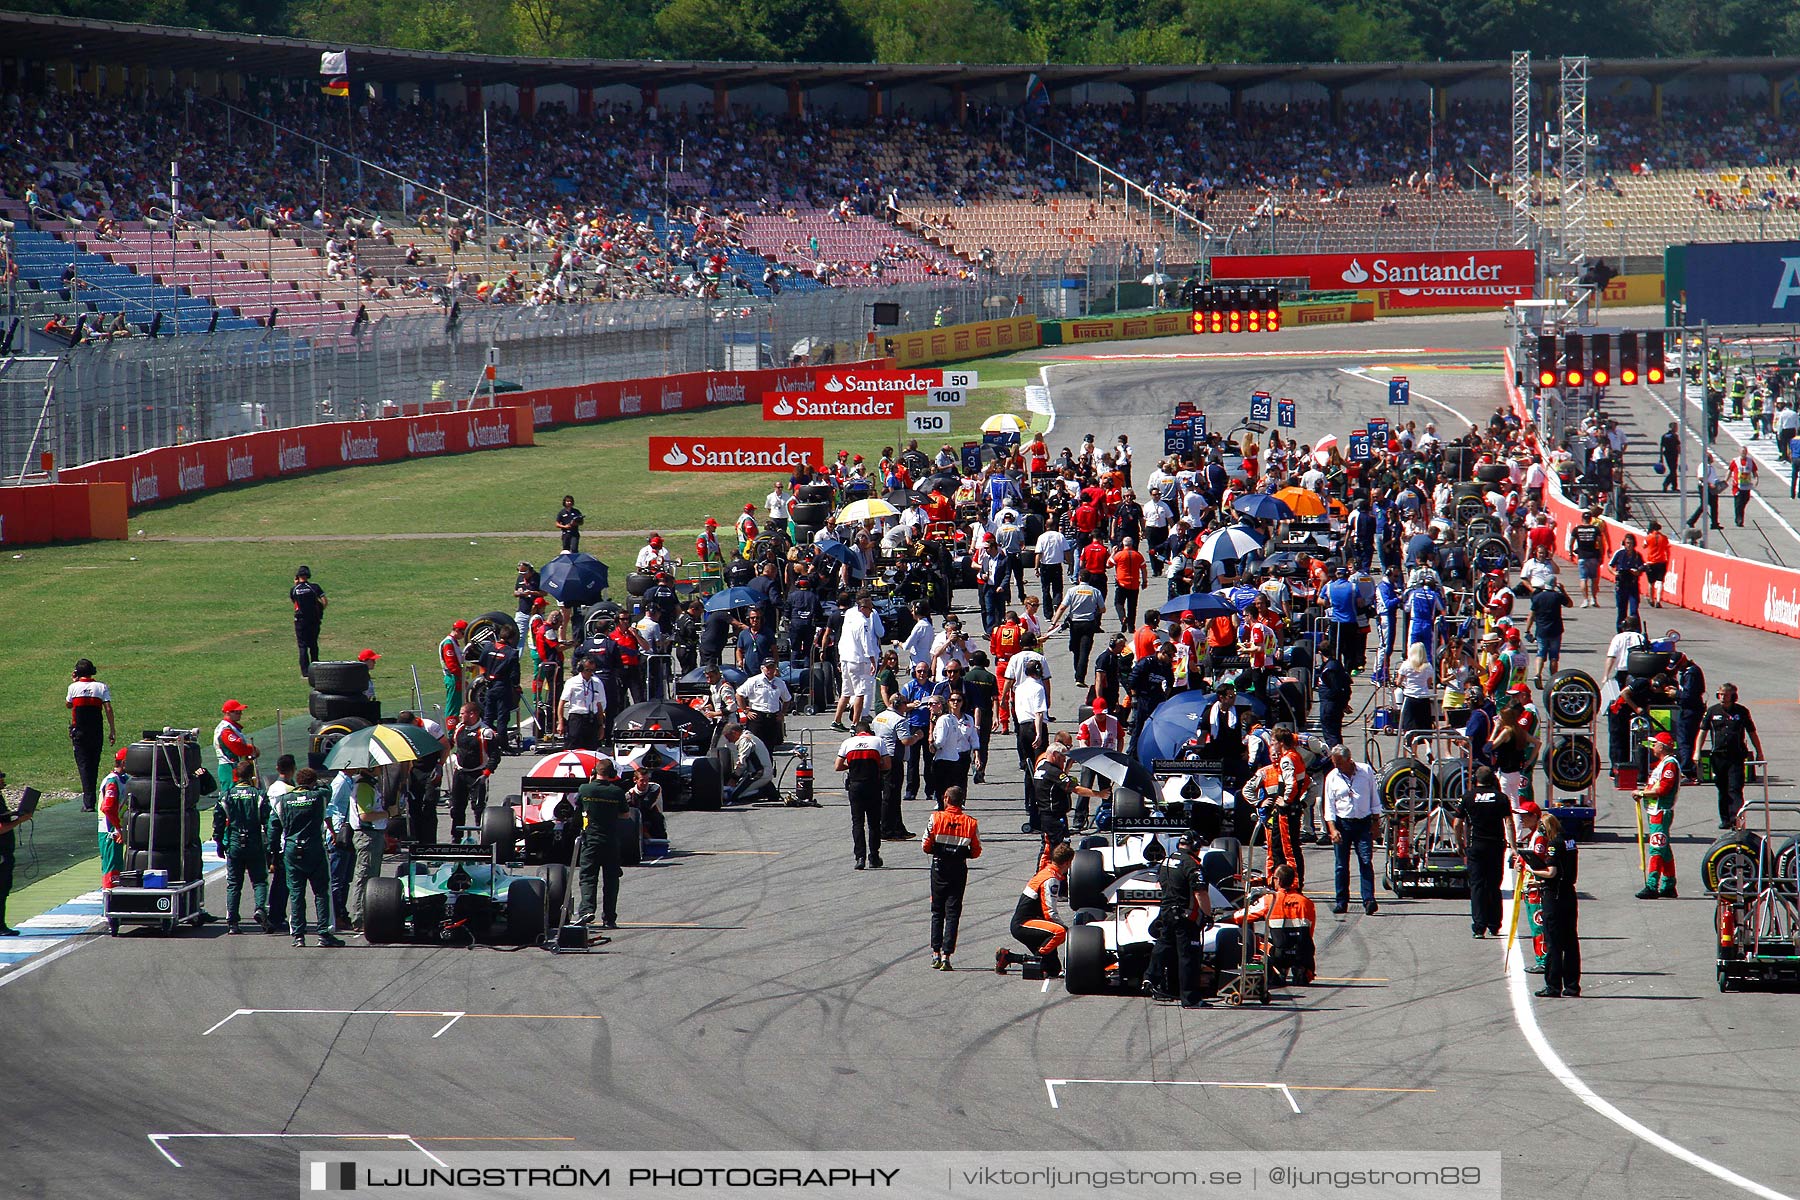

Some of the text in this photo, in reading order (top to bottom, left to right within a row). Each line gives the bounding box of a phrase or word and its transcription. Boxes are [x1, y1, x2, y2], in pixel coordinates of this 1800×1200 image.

[1373, 256, 1502, 283] Santander
[1298, 307, 1345, 323] PIRELLI
[1073, 322, 1114, 338] PIRELLI
[845, 373, 933, 392] Santander
[951, 375, 968, 386] 50
[933, 390, 961, 402] 100
[1396, 389, 1402, 400] 1
[796, 396, 894, 416] Santander
[1253, 404, 1269, 415] 24
[1281, 411, 1292, 422] 11
[914, 416, 943, 430] 150
[1194, 424, 1203, 436] 5
[1167, 438, 1185, 450] 26
[1354, 443, 1369, 455] 19
[691, 442, 811, 467] Santander
[967, 456, 976, 468] 3
[1475, 792, 1496, 801] MP
[160, 899, 168, 908] 18
